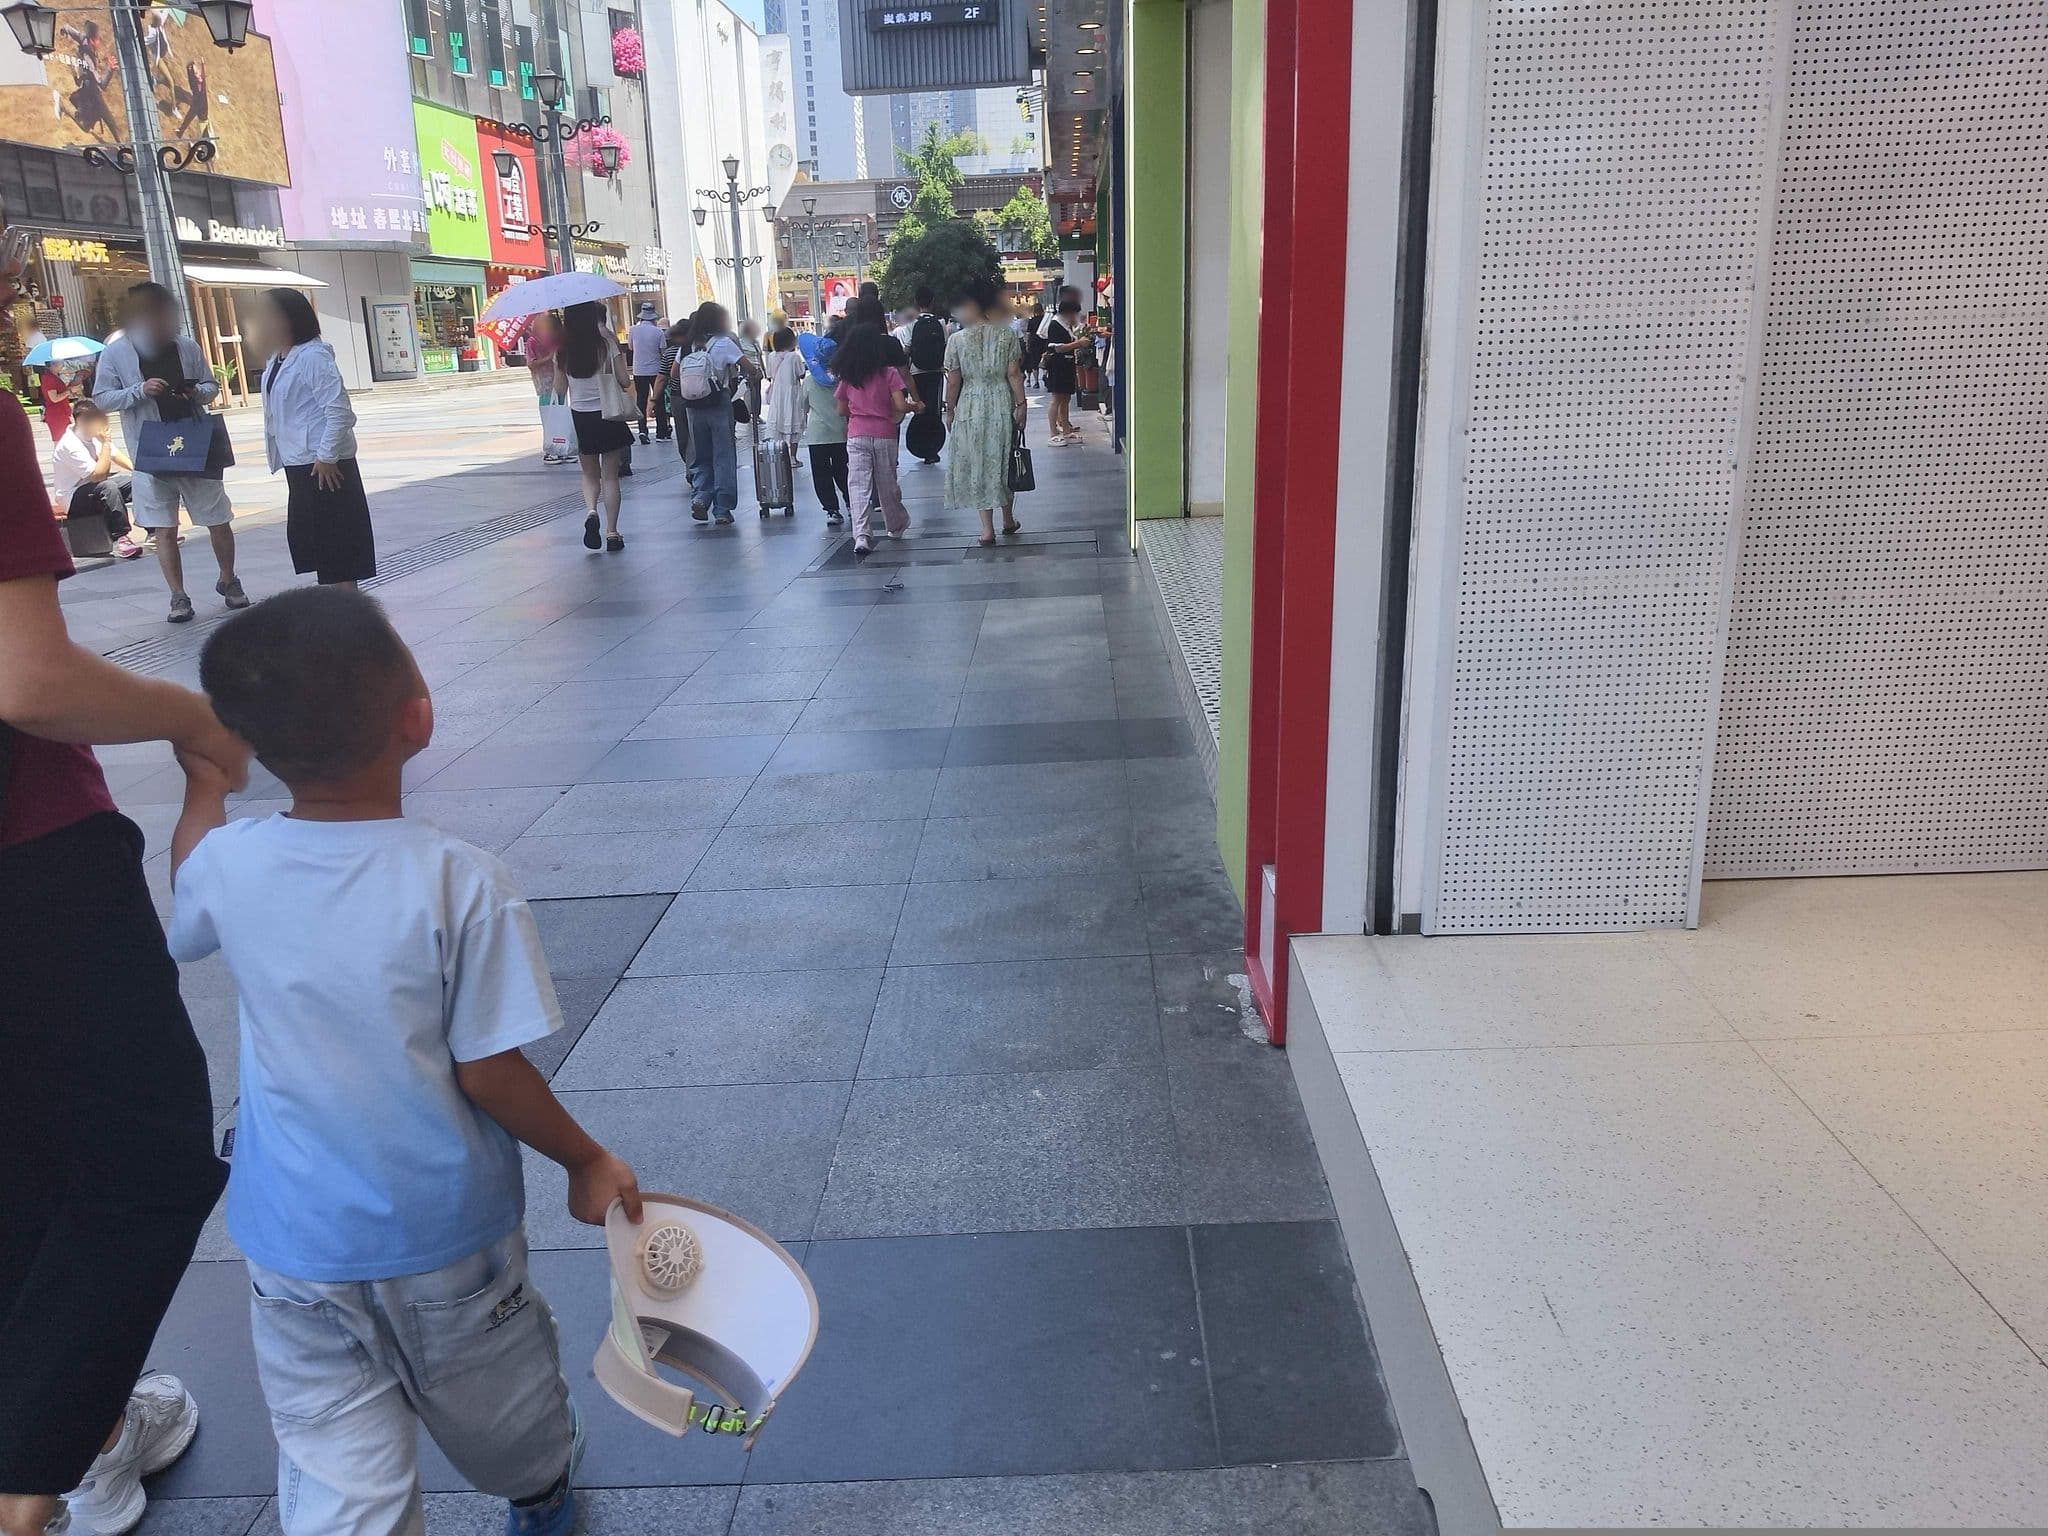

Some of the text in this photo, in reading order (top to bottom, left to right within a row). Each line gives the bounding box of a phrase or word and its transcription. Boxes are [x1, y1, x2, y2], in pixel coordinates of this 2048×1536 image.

[964, 7, 980, 19] 2F
[330, 206, 368, 230] 地址
[207, 219, 278, 247] Beneunder
